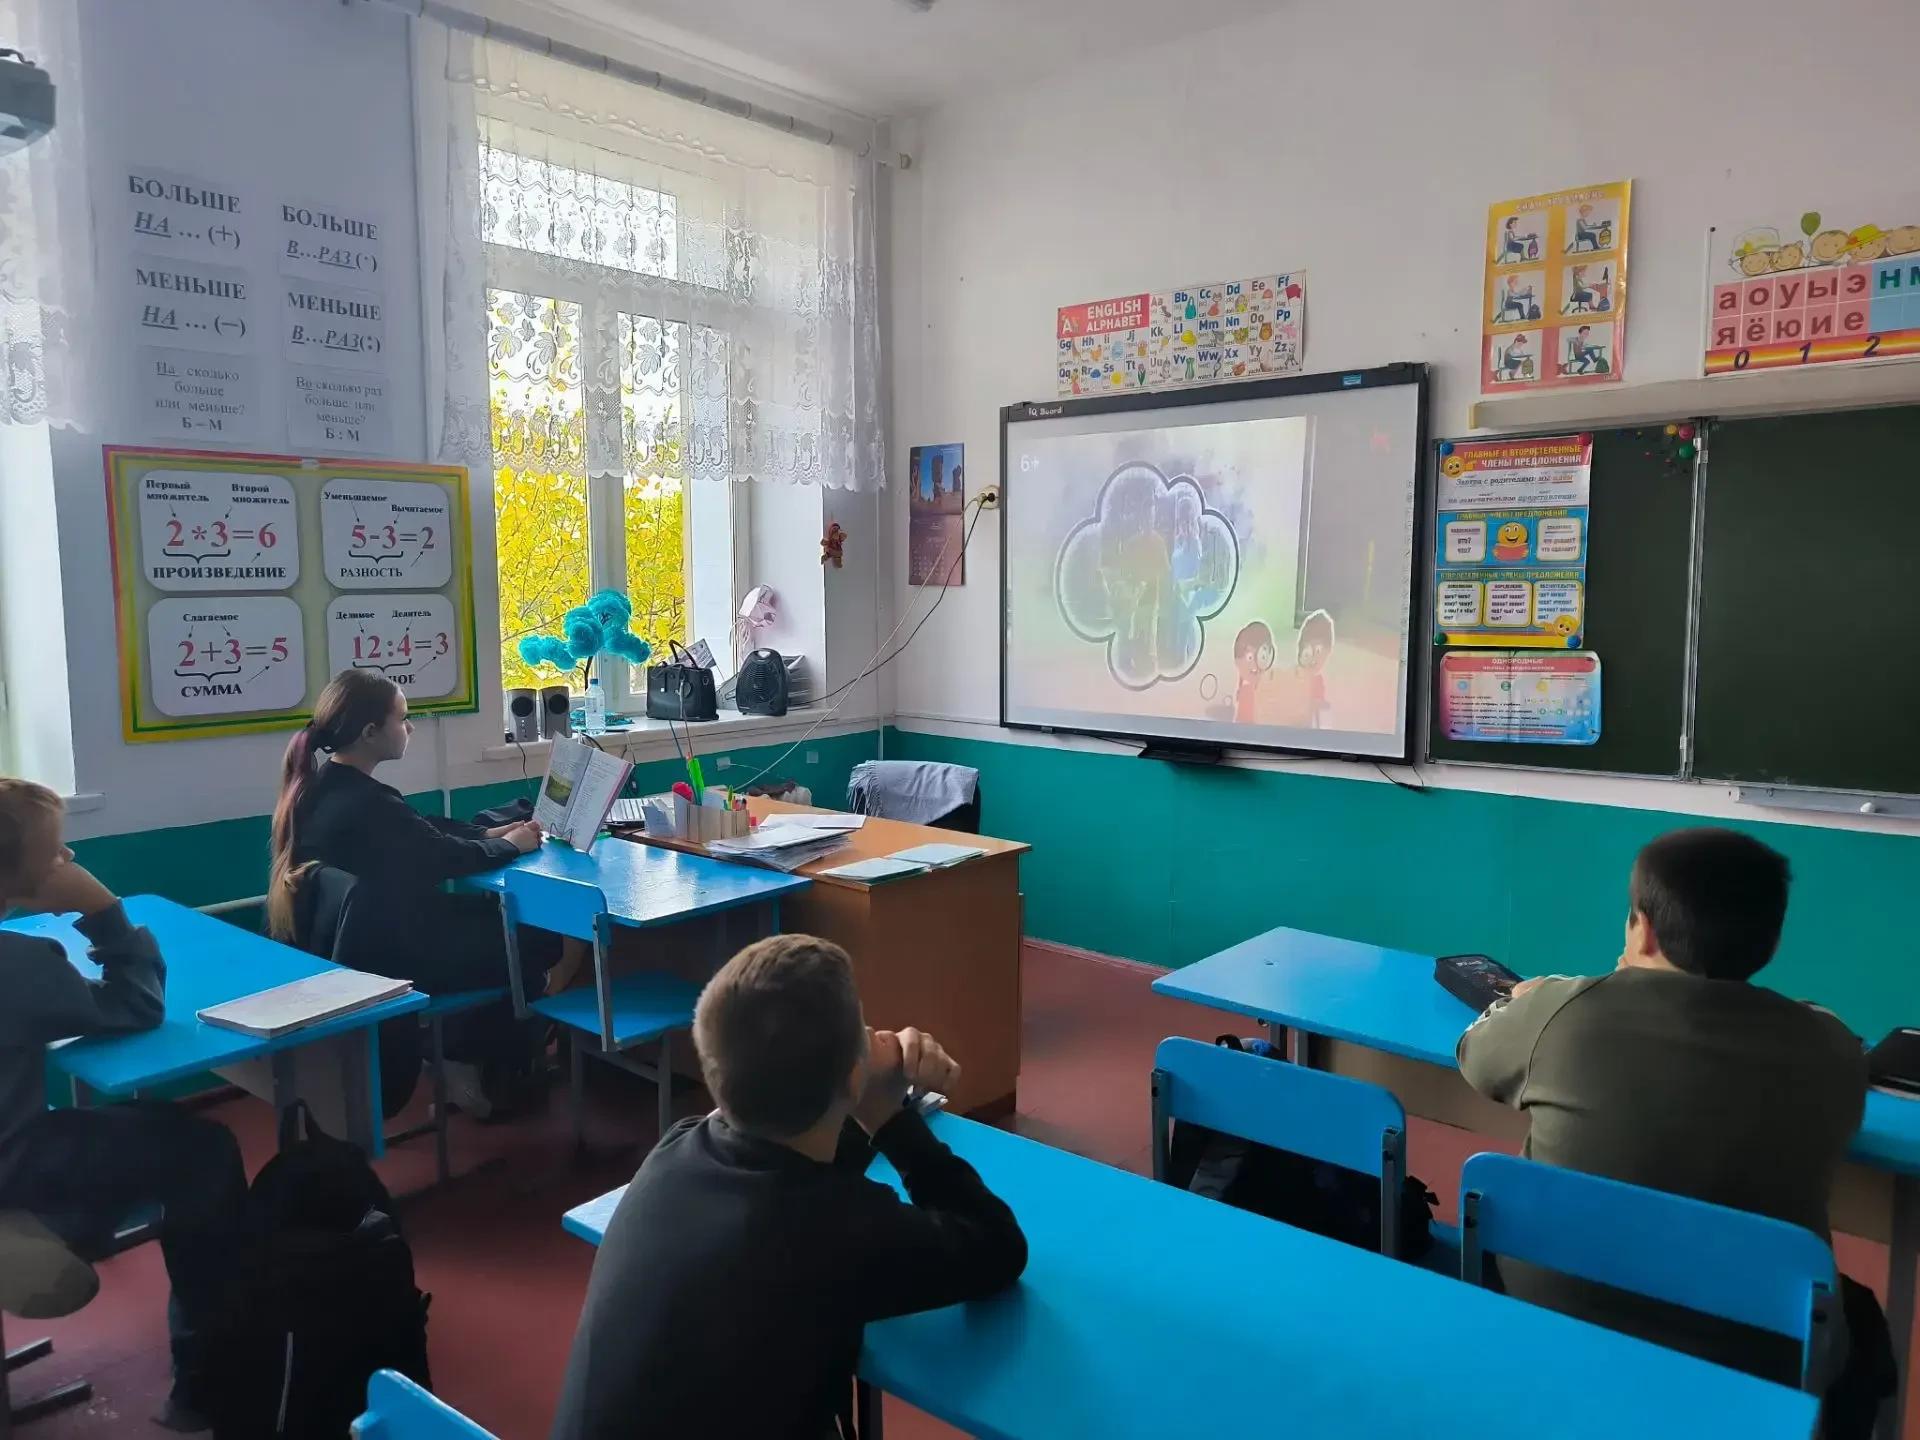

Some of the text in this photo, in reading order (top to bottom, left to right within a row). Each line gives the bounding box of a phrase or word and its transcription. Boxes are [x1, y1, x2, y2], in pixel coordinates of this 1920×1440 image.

[129, 175, 241, 213] БОЛЬШЕ
[135, 211, 172, 237] НА
[282, 205, 378, 240] БОЛЬШЕ
[136, 268, 246, 300] МЕНЬШЕ
[1252, 280, 1265, 292] Ee
[1278, 276, 1290, 288] Ff
[1200, 289, 1212, 299] Cc
[1227, 284, 1240, 295] Dd
[1719, 291, 1737, 310] а
[1749, 287, 1769, 305] о
[1780, 282, 1799, 309] у
[1808, 277, 1837, 298] ы
[1846, 273, 1866, 294] э
[1880, 269, 1901, 289] н
[1151, 296, 1163, 307] Aa
[1175, 292, 1188, 303] Bb
[288, 292, 381, 321] МЕНЬШЕ
[1087, 299, 1142, 320] ENGLISH
[142, 304, 179, 329] НА
[1226, 316, 1240, 327] Nn
[1250, 313, 1264, 324] Oo
[1276, 309, 1291, 322] Pp
[1087, 315, 1142, 333] ALPHABET
[1199, 319, 1219, 330] Mm
[1716, 311, 1865, 346] я ё ю и е
[1127, 330, 1135, 342] Jj
[1151, 326, 1164, 337] Kk
[1060, 339, 1072, 350] Gg
[1082, 336, 1094, 347] Hh
[1275, 342, 1287, 353] Zz
[1198, 351, 1219, 362] Ww
[1225, 348, 1239, 359] Xx
[1249, 345, 1262, 357] Yy
[1734, 335, 1881, 370] 0 1 2
[1126, 360, 1136, 371] Tt
[1150, 357, 1163, 368] Uu
[1174, 354, 1186, 365] Vv
[156, 361, 239, 381] На сколько
[1059, 368, 1071, 379] Qq
[1082, 366, 1092, 376] Rr
[1103, 363, 1114, 373] Ss
[174, 381, 224, 397] больше
[296, 377, 382, 397] Во сколько раз
[156, 398, 245, 416] или меньше?
[305, 394, 348, 408] больше
[1028, 406, 1062, 416] IQ Board
[317, 412, 366, 426] меньше?
[1464, 449, 1500, 459] ГЛАВНЫЕ
[1509, 444, 1582, 456] ВТОРОСТЕПЕННЫЕ
[1021, 454, 1040, 472] 6+
[1481, 455, 1581, 468] ЧЛЕНЫ ПРЕДЛОЖЕНИЯ
[146, 479, 191, 491] Первый
[232, 483, 269, 495] Второй
[146, 492, 209, 503] множитель
[232, 495, 290, 505] множитель
[324, 491, 388, 502] Уменьшаемое
[391, 503, 443, 515] Вычитаемое
[153, 566, 286, 580] ПРОИЗВЕДЕНИЕ
[340, 567, 403, 579] РАЗНОСТЬ
[183, 612, 239, 623] Слагаемое
[335, 610, 375, 620] Делимое
[391, 609, 431, 619] Делитель
[181, 684, 242, 698] СУММА
